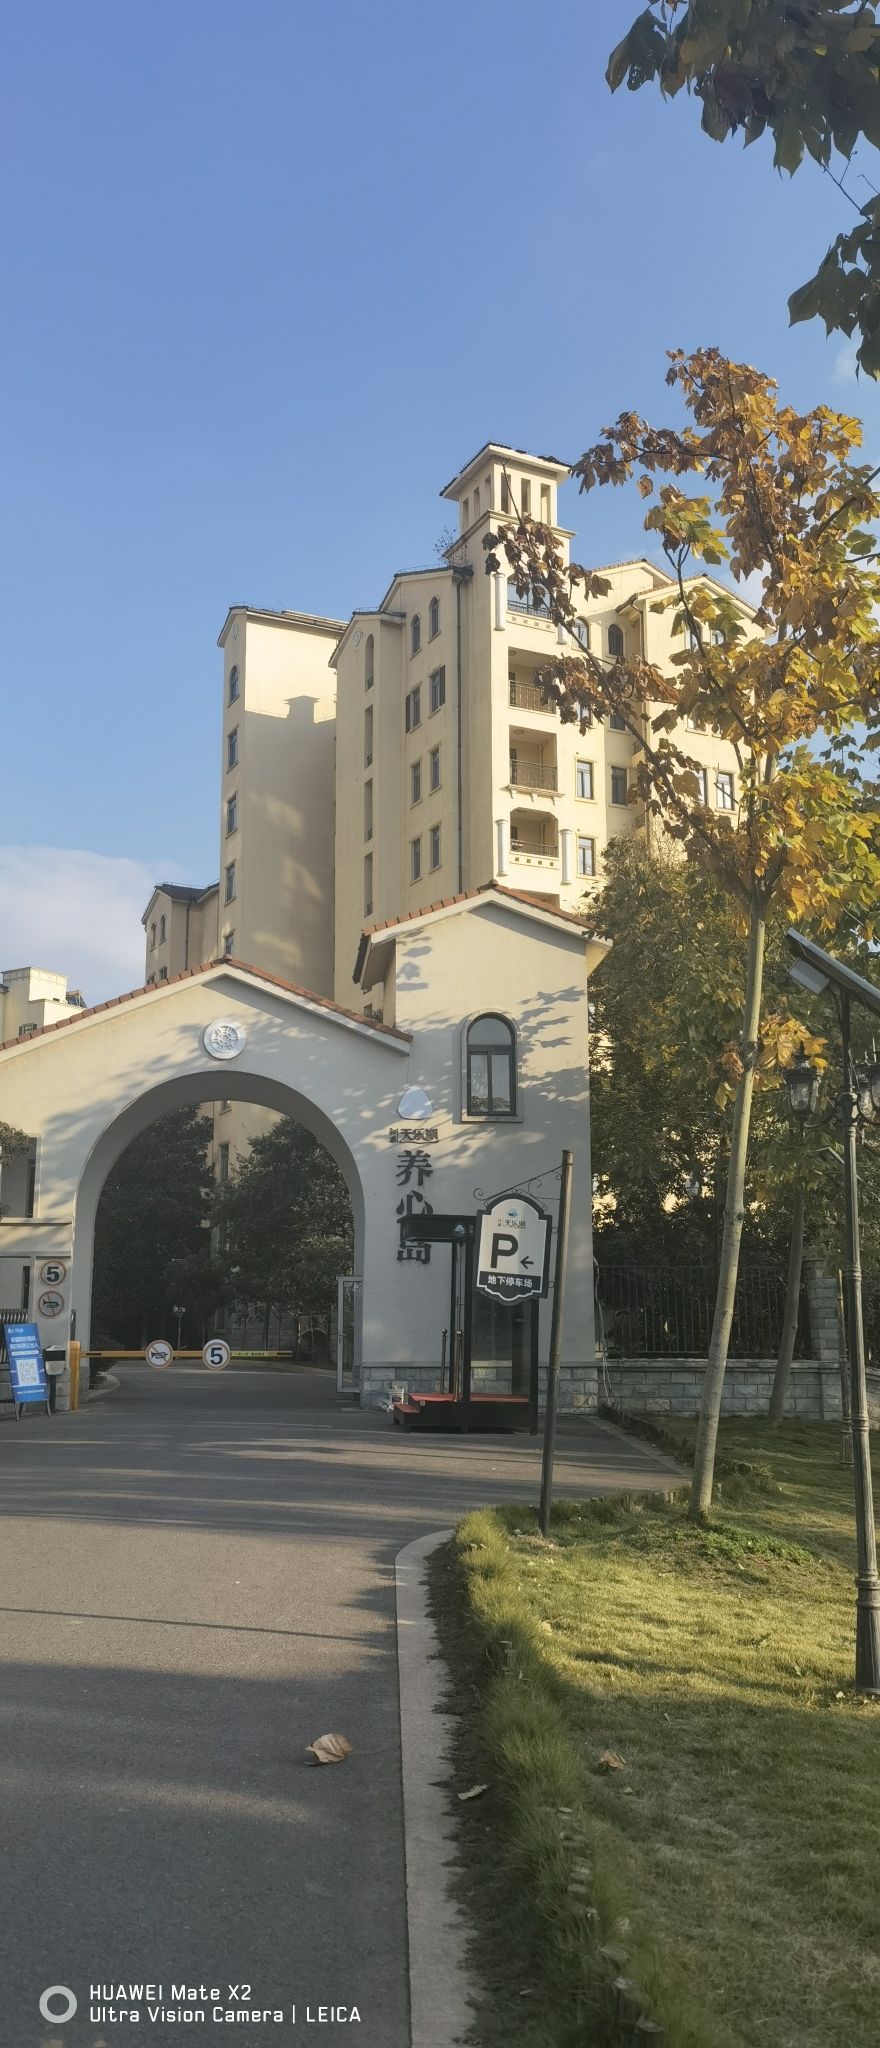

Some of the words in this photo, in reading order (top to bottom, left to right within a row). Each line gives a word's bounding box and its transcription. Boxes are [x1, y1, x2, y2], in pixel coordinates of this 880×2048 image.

[396, 1149, 434, 1265] 养心岛
[490, 1232, 519, 1269] P
[46, 1266, 60, 1282] 5
[487, 1274, 533, 1288] 地下停车场
[210, 1347, 224, 1365] 5
